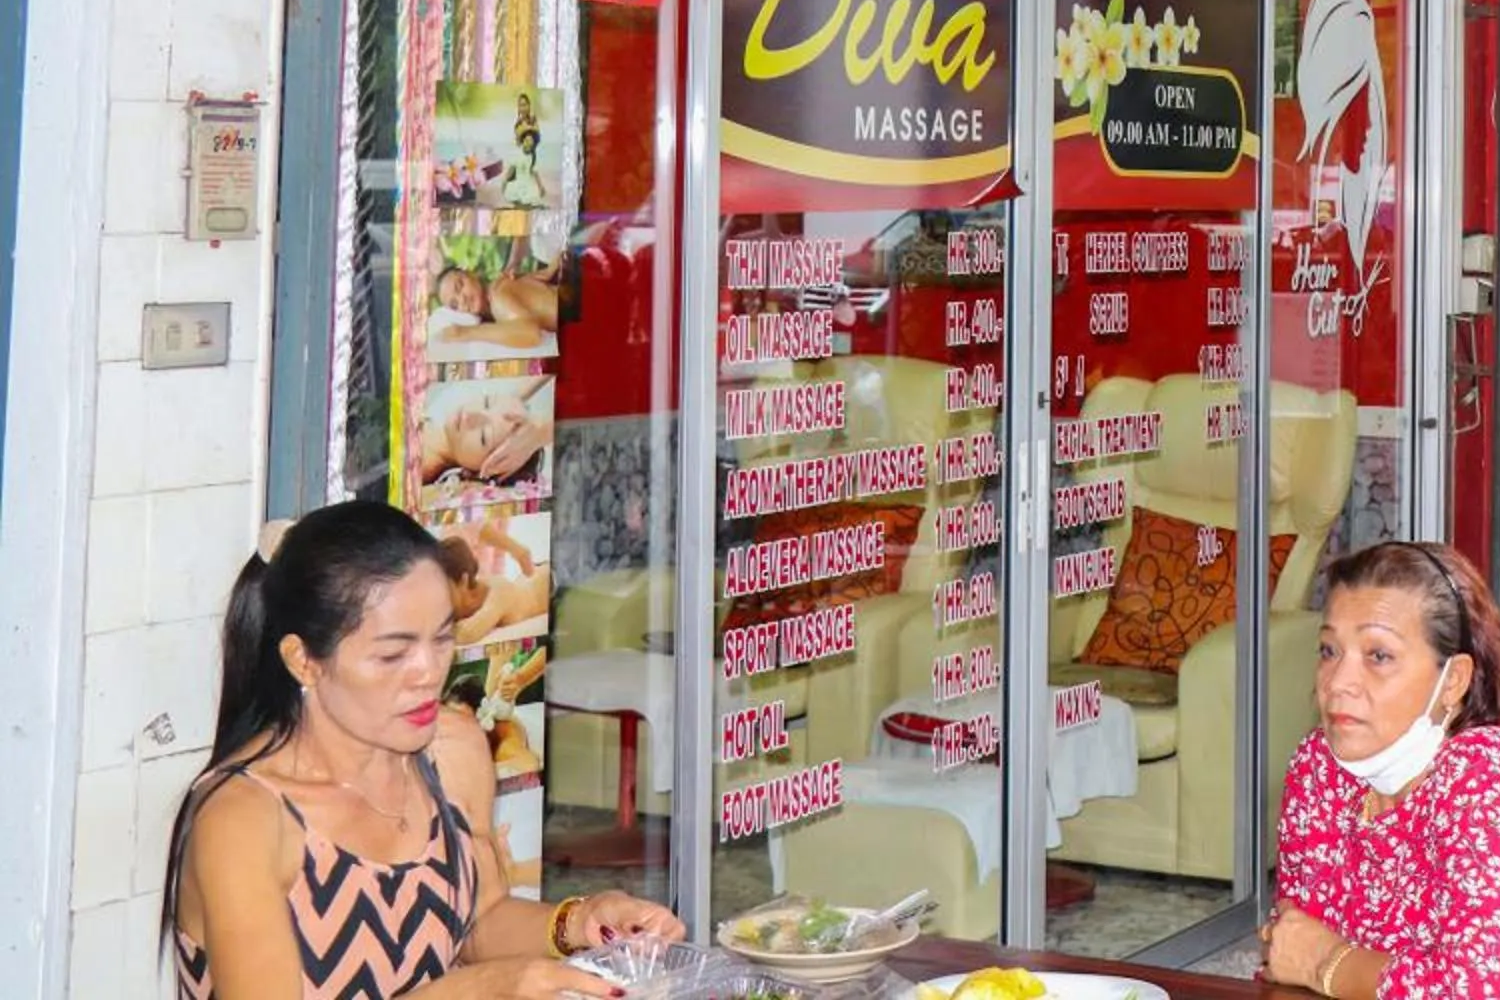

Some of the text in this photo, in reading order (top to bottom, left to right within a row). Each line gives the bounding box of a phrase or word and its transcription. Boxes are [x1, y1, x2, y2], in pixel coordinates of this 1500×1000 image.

[1154, 84, 1196, 110] OPEN
[854, 106, 984, 142] MASSAGE
[1107, 119, 1143, 145] 09.00
[1145, 123, 1170, 147] AM
[1181, 125, 1212, 150] 11.00
[1215, 127, 1237, 150] PM
[726, 239, 768, 290] THAI
[769, 238, 844, 287] MASSAGE
[1291, 242, 1339, 291] Hair
[725, 315, 755, 364] OIL
[756, 310, 833, 361] MASSAGE
[1307, 289, 1345, 338] Cut
[725, 388, 768, 441] MILK
[770, 381, 845, 435] MASSAGE
[1055, 418, 1095, 465] FACIAL
[1096, 412, 1162, 459] TREATMENT
[724, 455, 854, 520] AROMATHERAPY
[856, 444, 926, 498] MASSAGE
[1055, 479, 1126, 530] FOOT SCRUB
[724, 535, 811, 598] ALOEVERA
[813, 521, 886, 581] MASSAGE
[1055, 548, 1116, 598] MANICURE
[723, 621, 779, 681] SPORT
[780, 604, 855, 668] MASSAGE
[1054, 680, 1101, 731] WAXING
[721, 708, 758, 763] HOT
[759, 701, 790, 751] OIL
[720, 782, 765, 843] FOOT
[765, 758, 843, 830] MASSAGE
